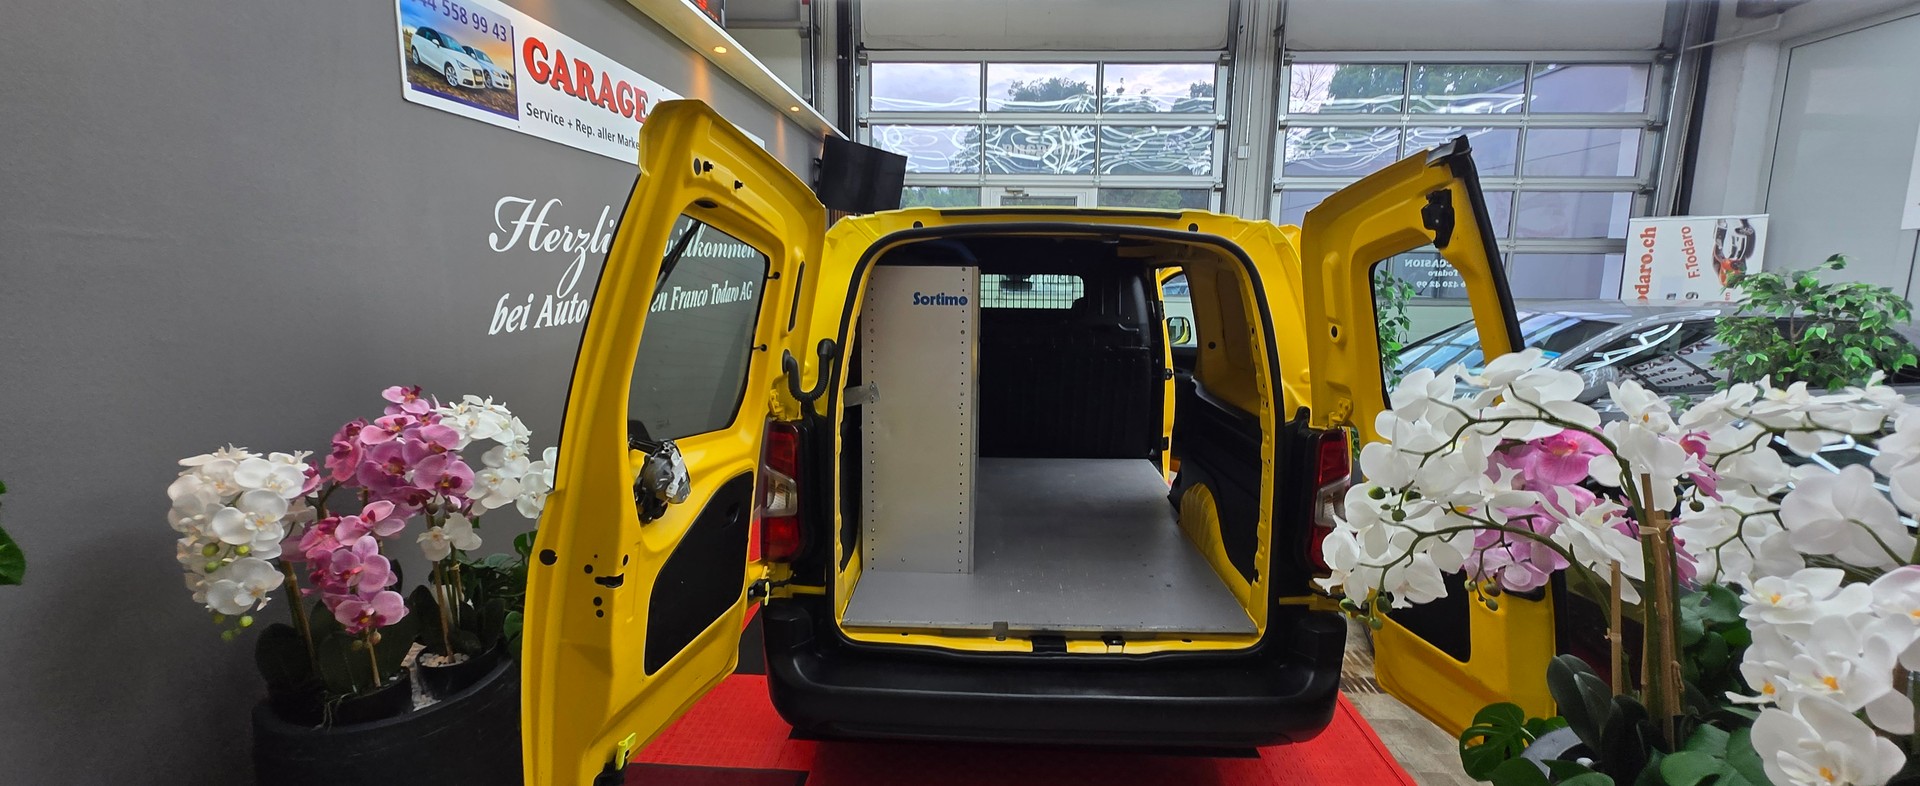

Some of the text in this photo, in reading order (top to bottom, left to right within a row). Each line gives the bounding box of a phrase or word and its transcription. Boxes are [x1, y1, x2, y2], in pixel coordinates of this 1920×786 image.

[442, 0, 468, 25] 558
[472, 12, 488, 34] 99
[492, 23, 507, 42] 43
[522, 36, 650, 124] GARAGE
[526, 102, 565, 127] Service
[575, 118, 596, 138] Rep.
[597, 126, 616, 143] aller
[488, 293, 534, 335] bei
[533, 292, 590, 329] Auto
[669, 286, 708, 311] Franco
[711, 280, 740, 305] Todaro
[740, 281, 753, 301] AG
[913, 291, 969, 306] Sortimo
